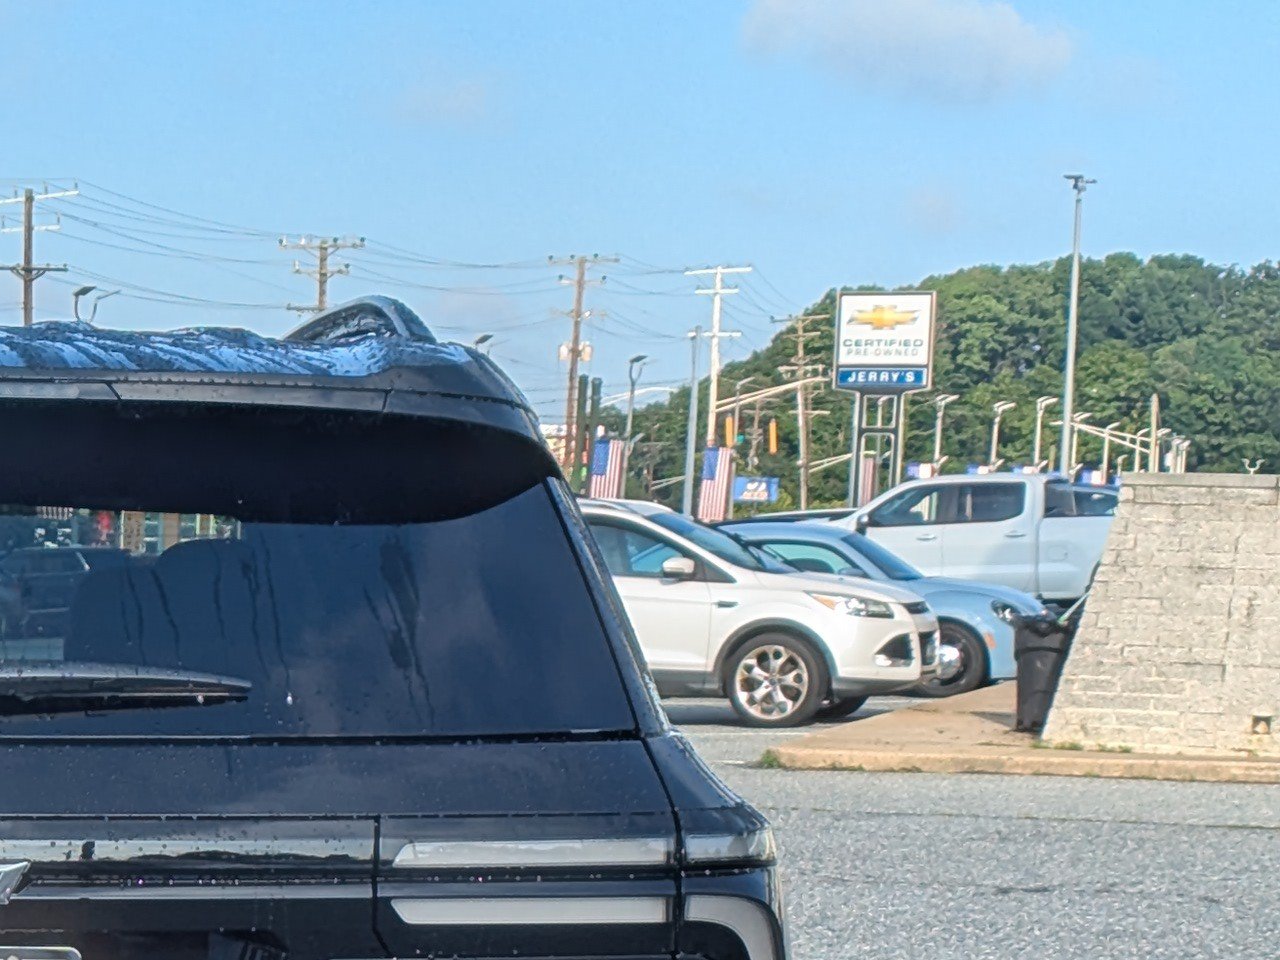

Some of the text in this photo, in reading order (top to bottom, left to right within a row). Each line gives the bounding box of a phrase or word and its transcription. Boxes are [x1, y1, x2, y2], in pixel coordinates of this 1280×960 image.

[842, 338, 924, 347] CERTIFIED
[846, 347, 919, 357] PRE-OWNED
[847, 371, 915, 383] JERRY'S
